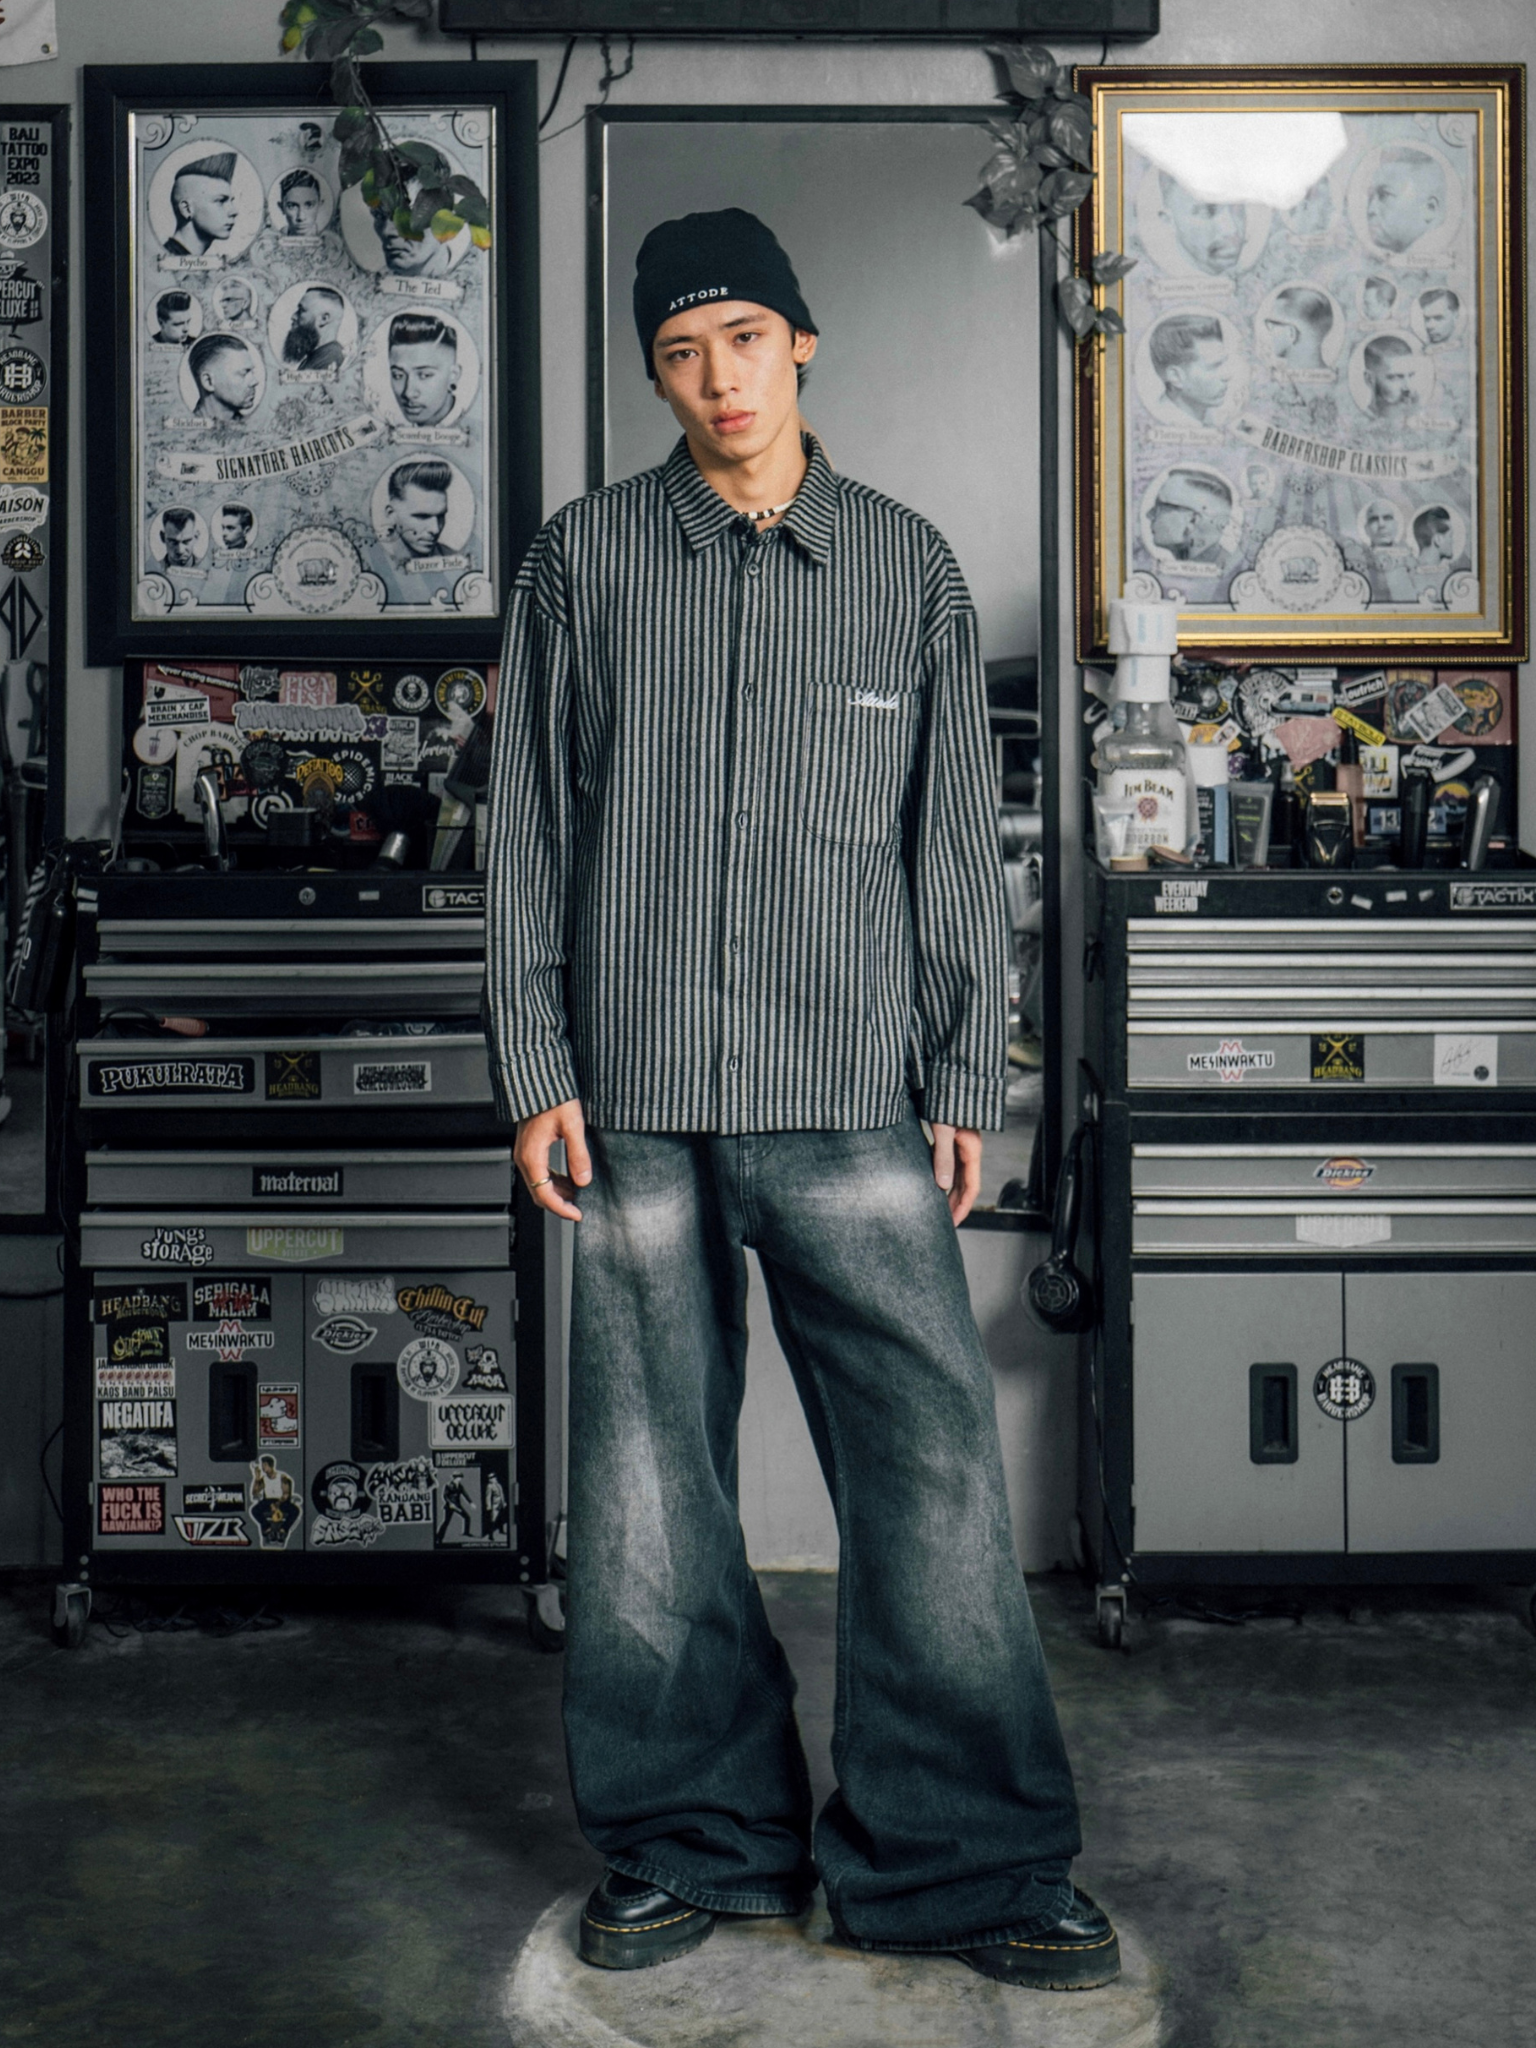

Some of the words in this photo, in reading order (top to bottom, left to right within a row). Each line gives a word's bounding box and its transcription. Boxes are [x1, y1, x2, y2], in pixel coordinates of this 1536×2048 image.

[9, 127, 39, 141] BALI
[1, 143, 47, 156] TATTOO
[8, 157, 39, 171] EXPO
[7, 171, 39, 185] 2023
[179, 257, 208, 270] Psycho
[395, 279, 418, 293] The
[421, 282, 442, 295] Ted
[1, 409, 46, 419] BARBER
[216, 451, 287, 480] SIGNATURE
[292, 426, 355, 467] HAIRCUTS
[1262, 427, 1346, 471] BARBERSHOP
[1350, 450, 1407, 476] CLASSICS
[2, 467, 45, 476] CANGGU
[413, 560, 439, 571] Razor
[151, 704, 177, 713] BRAIN
[188, 702, 205, 711] CAP
[148, 711, 209, 721] MERCHANDISE
[386, 773, 413, 782] BLACK
[1124, 783, 1142, 798] JIM
[1144, 780, 1174, 800] BEAM
[1162, 881, 1208, 898] EVERYDAY
[1474, 889, 1534, 904] TACTIX
[1155, 896, 1198, 912] WEEKEND
[100, 1062, 244, 1093] PUKULRATA
[1323, 1168, 1369, 1178] Dickies
[260, 1171, 339, 1192] maternal
[251, 1228, 339, 1251] UPPERCUT
[194, 1282, 270, 1306] SERIGALA
[101, 1294, 182, 1317] HEADBANG
[208, 1301, 257, 1317] MALAM
[322, 1329, 368, 1340] Dickies
[97, 1386, 120, 1397] KAOS
[122, 1386, 146, 1397] BAND
[148, 1386, 174, 1397] PALSU
[102, 1400, 174, 1430] NEGATIFA
[441, 1452, 475, 1460] UPPERCUT
[441, 1458, 466, 1467] DELUXE
[102, 1487, 134, 1502] WHO
[137, 1486, 160, 1502] THE
[102, 1503, 142, 1520] FUCK
[145, 1502, 162, 1519] IS
[380, 1503, 431, 1522] BABI
